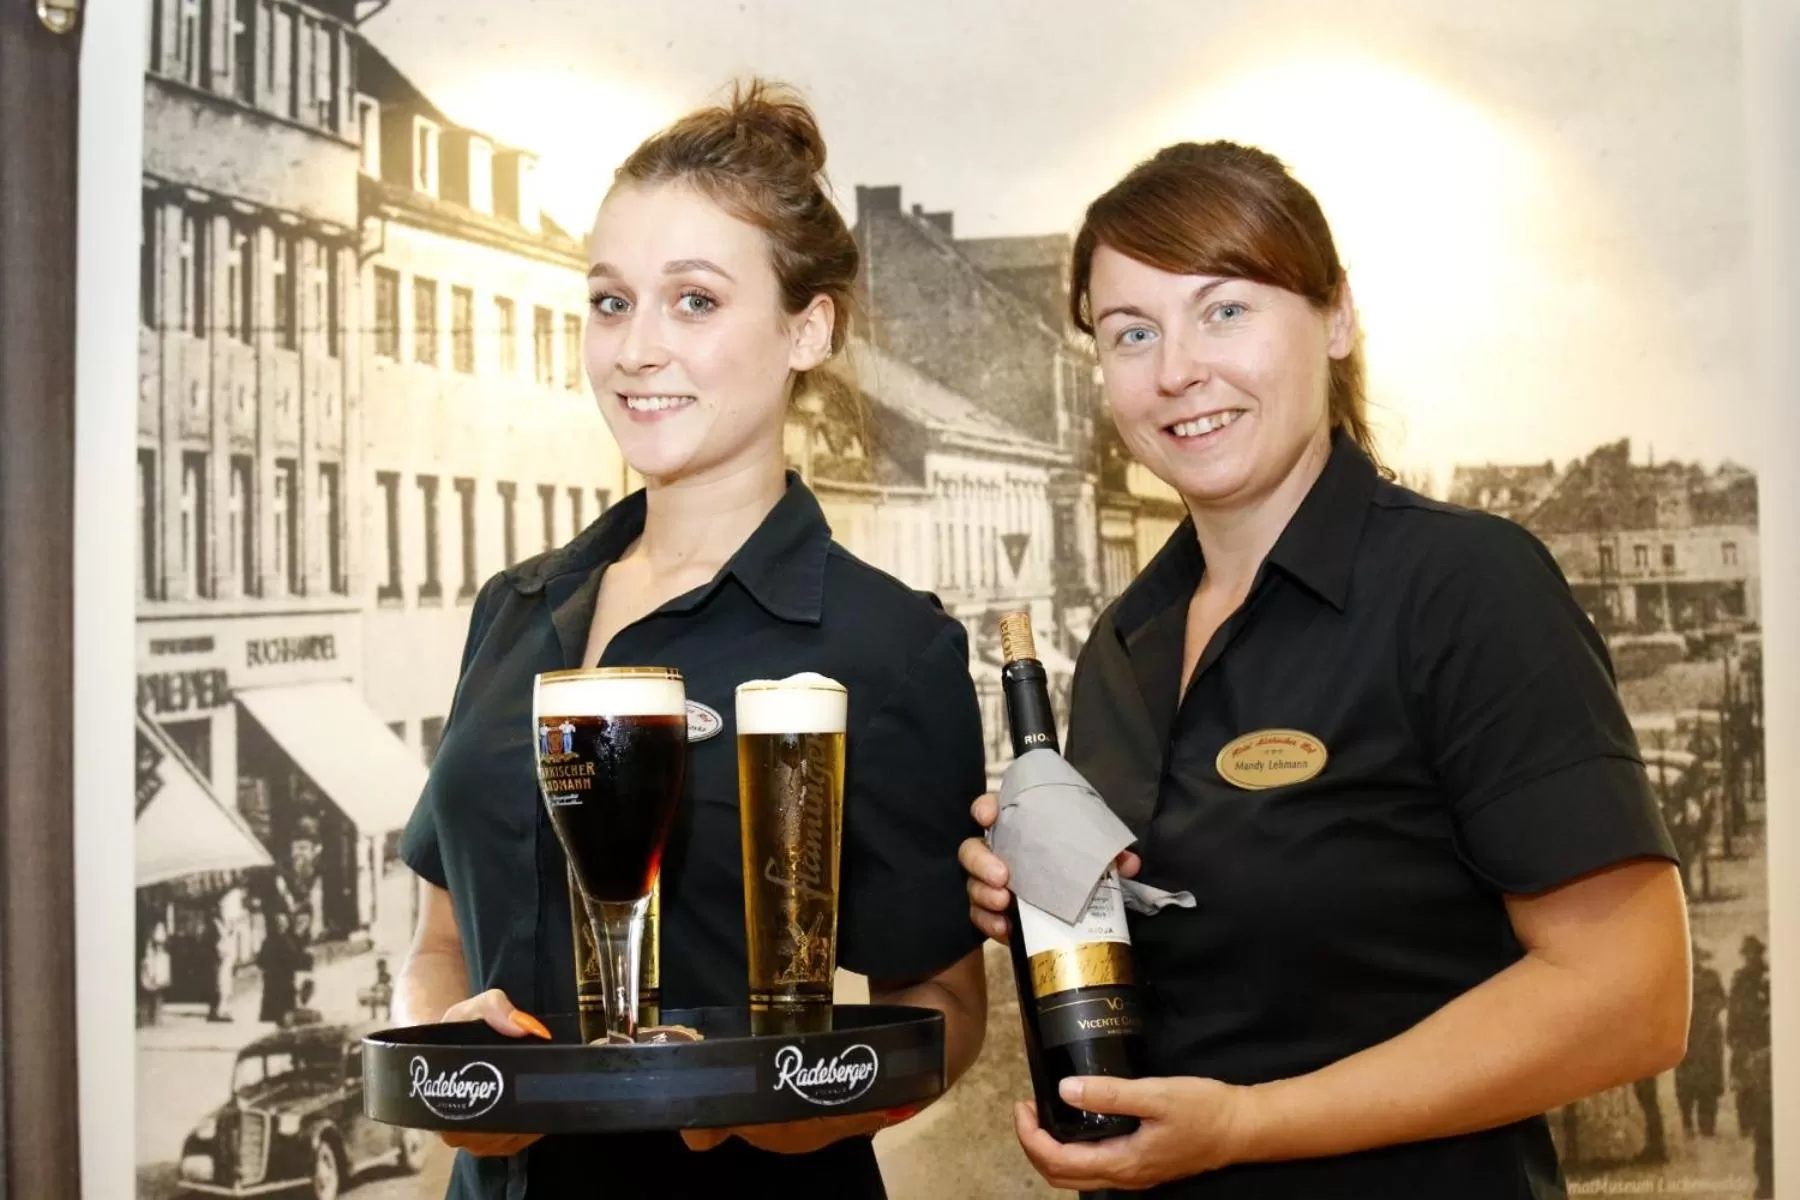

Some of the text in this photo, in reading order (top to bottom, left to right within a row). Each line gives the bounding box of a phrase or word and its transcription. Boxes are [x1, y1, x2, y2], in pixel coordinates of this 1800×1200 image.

[1024, 732, 1052, 745] RIO
[1234, 760, 1308, 772] Mandy Lehmann
[544, 777, 592, 792] ANDMANN
[1077, 1018, 1121, 1030] VICENTE
[774, 1045, 873, 1090] Radeberger
[409, 1055, 497, 1108] Radeberger
